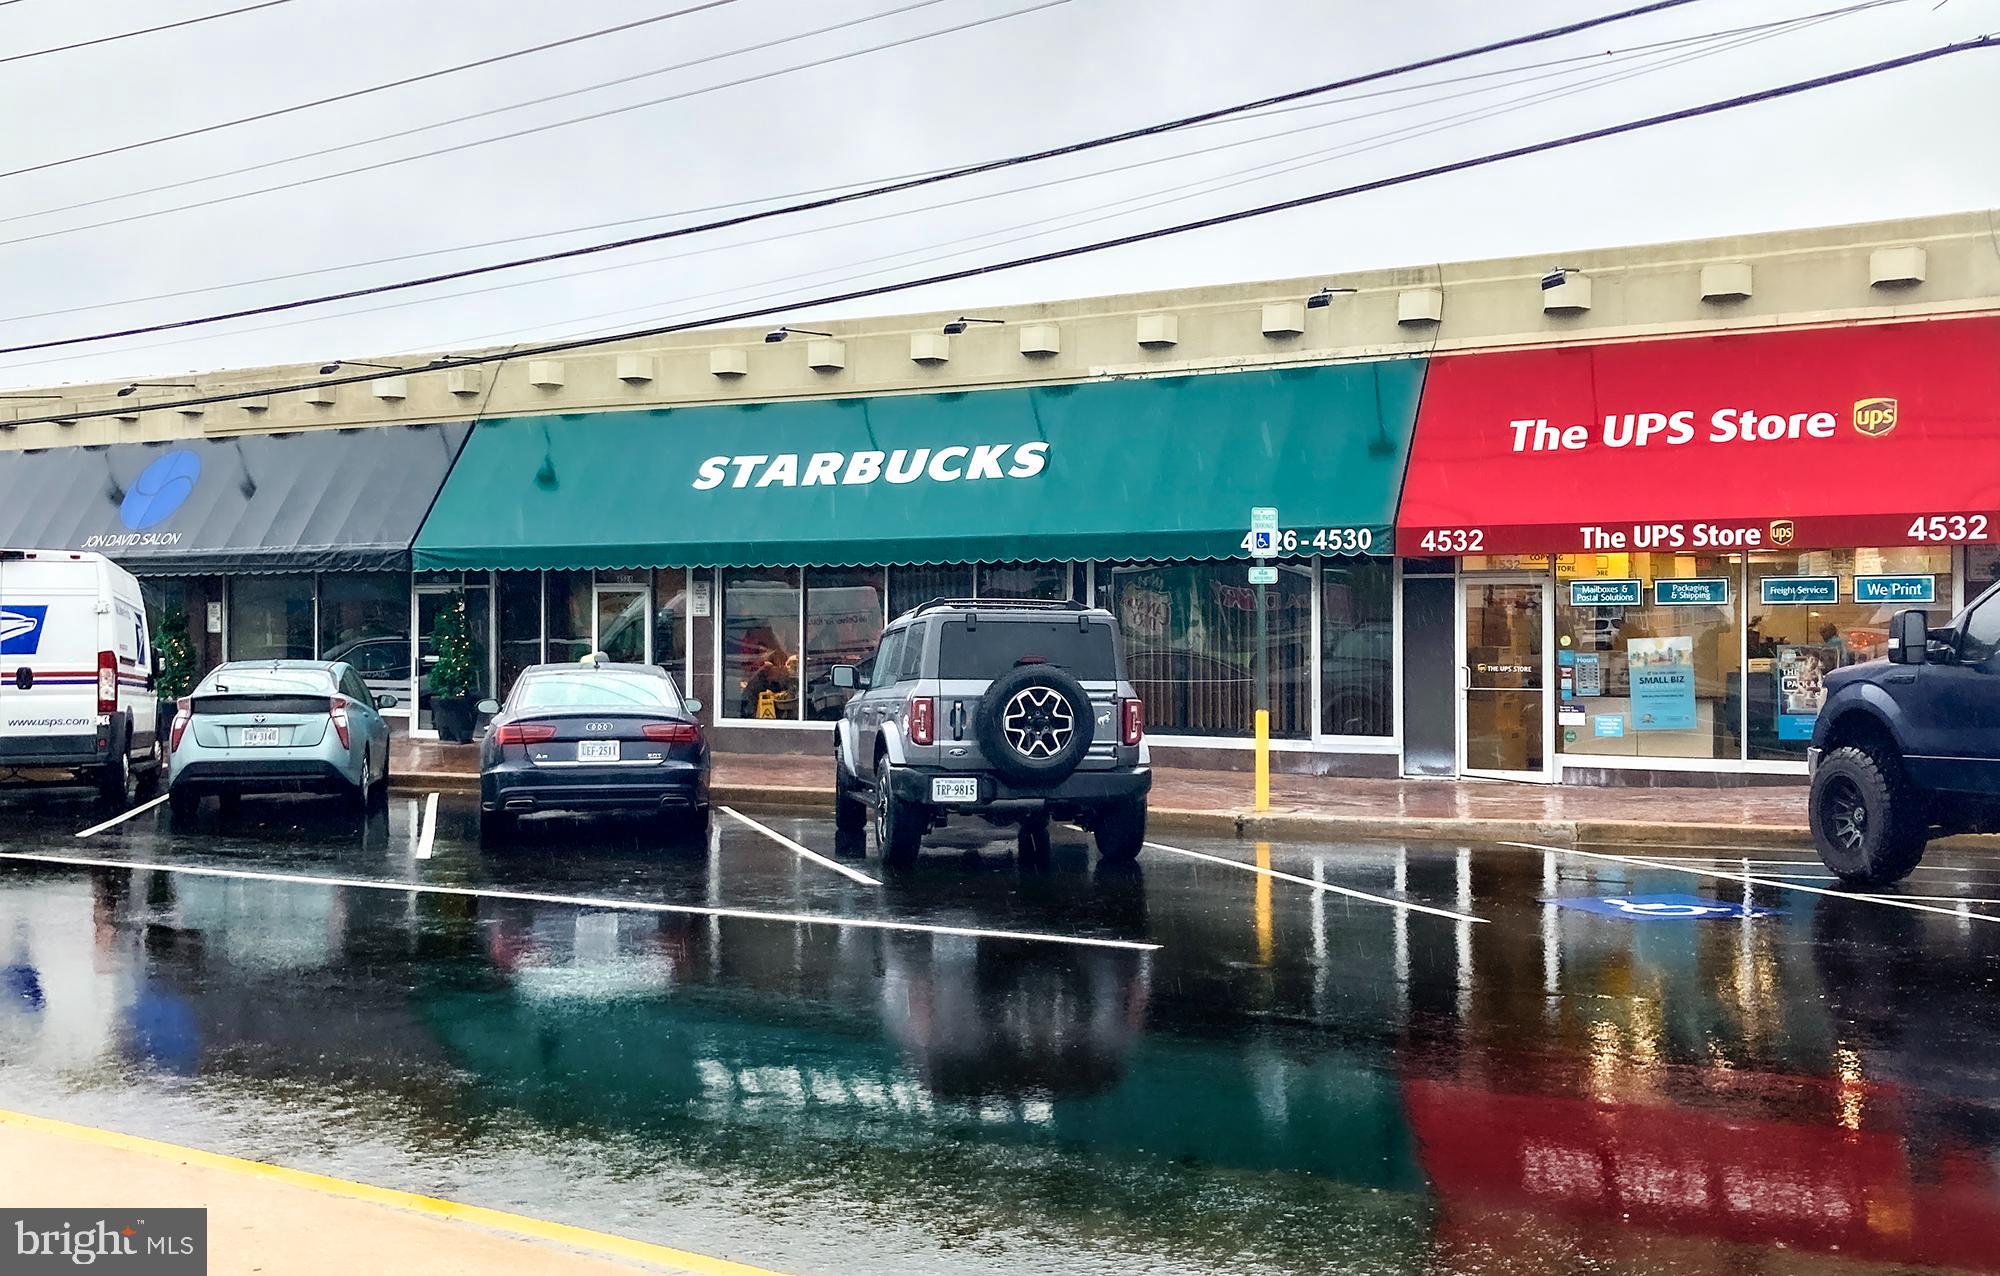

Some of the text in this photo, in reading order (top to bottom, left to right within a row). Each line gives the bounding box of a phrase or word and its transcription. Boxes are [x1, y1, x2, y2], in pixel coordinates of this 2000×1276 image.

[1856, 408, 1894, 428] ups
[1510, 408, 1837, 452] The UPS Store
[691, 442, 1050, 490] STARBUCKS
[1772, 526, 1792, 541] ups
[1907, 514, 1988, 541] 4532
[81, 532, 182, 548] JON DAVID SALON
[1240, 528, 1372, 552] 46-4530
[1420, 529, 1484, 552] 4532
[1580, 524, 1761, 549] The UPS Store
[1622, 585, 1629, 593] &
[1672, 585, 1710, 594] Packaging
[1679, 592, 1711, 600] Shipping
[1770, 586, 1829, 596] Freight Services
[1867, 583, 1922, 596] We Print
[1577, 593, 1634, 602] Postal Solutions
[1639, 675, 1685, 685] SMALL BIZ
[8, 718, 90, 728] www.usps.com
[936, 784, 975, 796] TRP-9815
